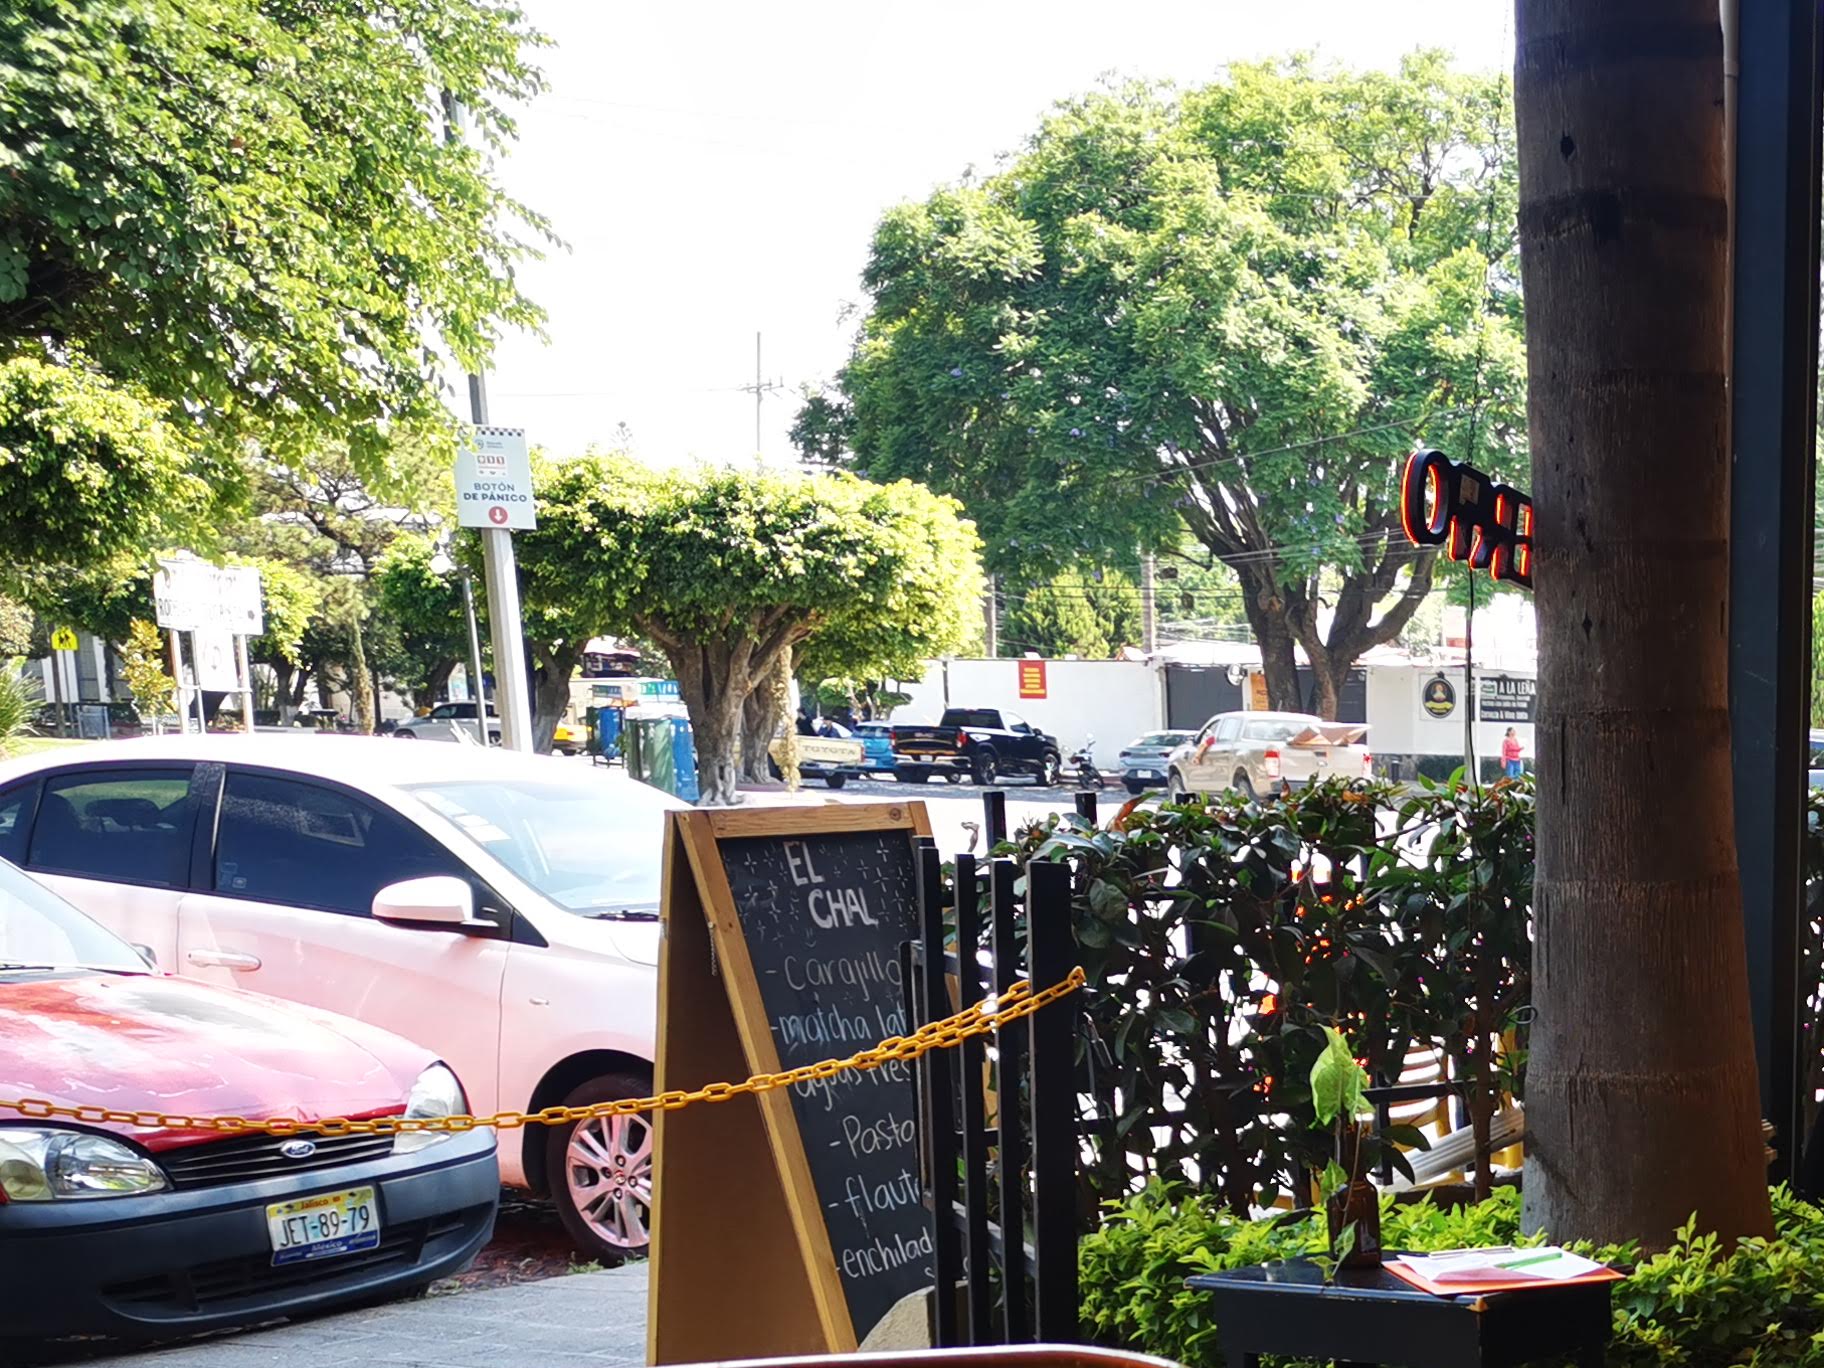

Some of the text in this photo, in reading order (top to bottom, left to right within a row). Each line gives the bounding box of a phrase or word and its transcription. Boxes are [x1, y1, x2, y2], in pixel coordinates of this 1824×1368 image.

[463, 492, 527, 502] DE PÁNICO
[474, 482, 515, 492] BOTÓN
[802, 744, 856, 756] TOYOTA
[784, 841, 825, 886] EL
[808, 887, 879, 929] CHAL
[281, 1204, 370, 1248] JET-89-79
